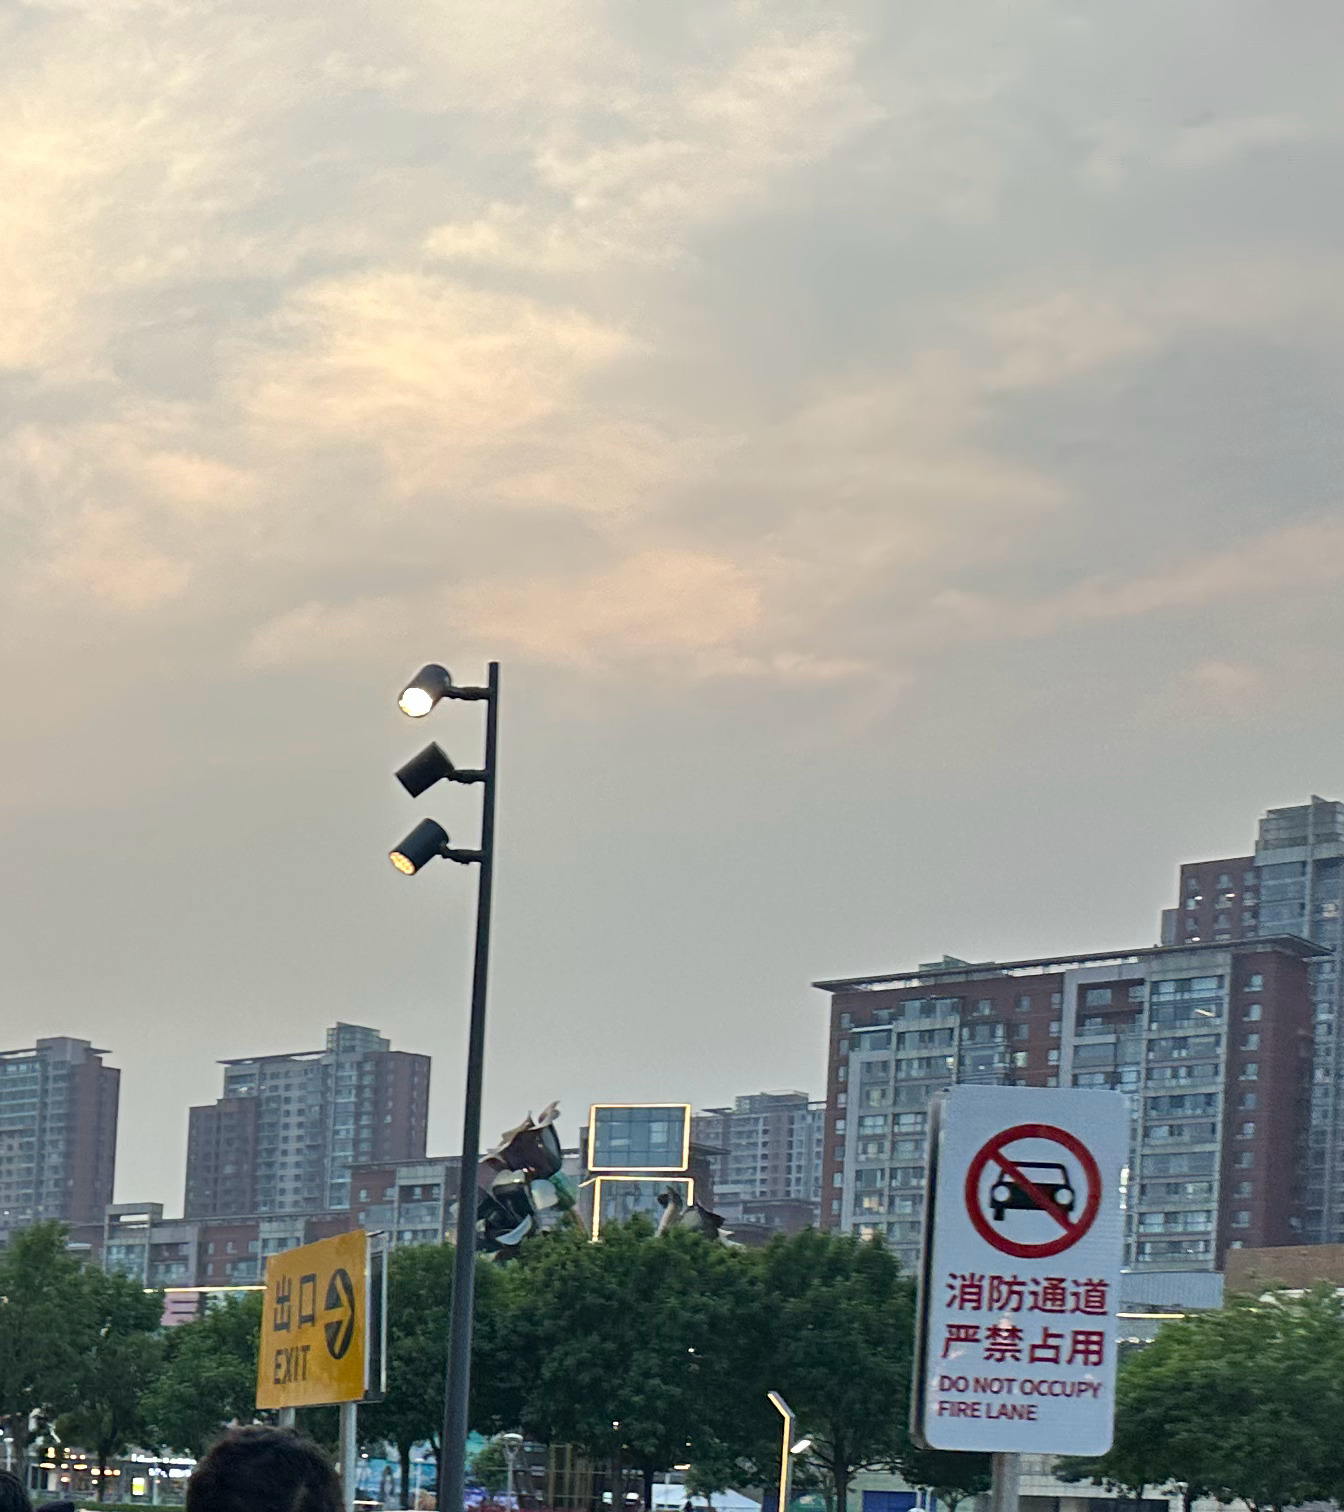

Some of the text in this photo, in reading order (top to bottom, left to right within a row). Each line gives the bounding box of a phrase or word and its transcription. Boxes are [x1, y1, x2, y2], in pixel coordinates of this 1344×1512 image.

[273, 1272, 317, 1333] 出口
[944, 1272, 1110, 1317] 消防通道
[274, 1345, 311, 1385] EXIT
[940, 1323, 1105, 1368] 严禁占用
[939, 1374, 1102, 1399] DO NOT OCCUPY
[937, 1400, 1038, 1422] FIRE LANE
